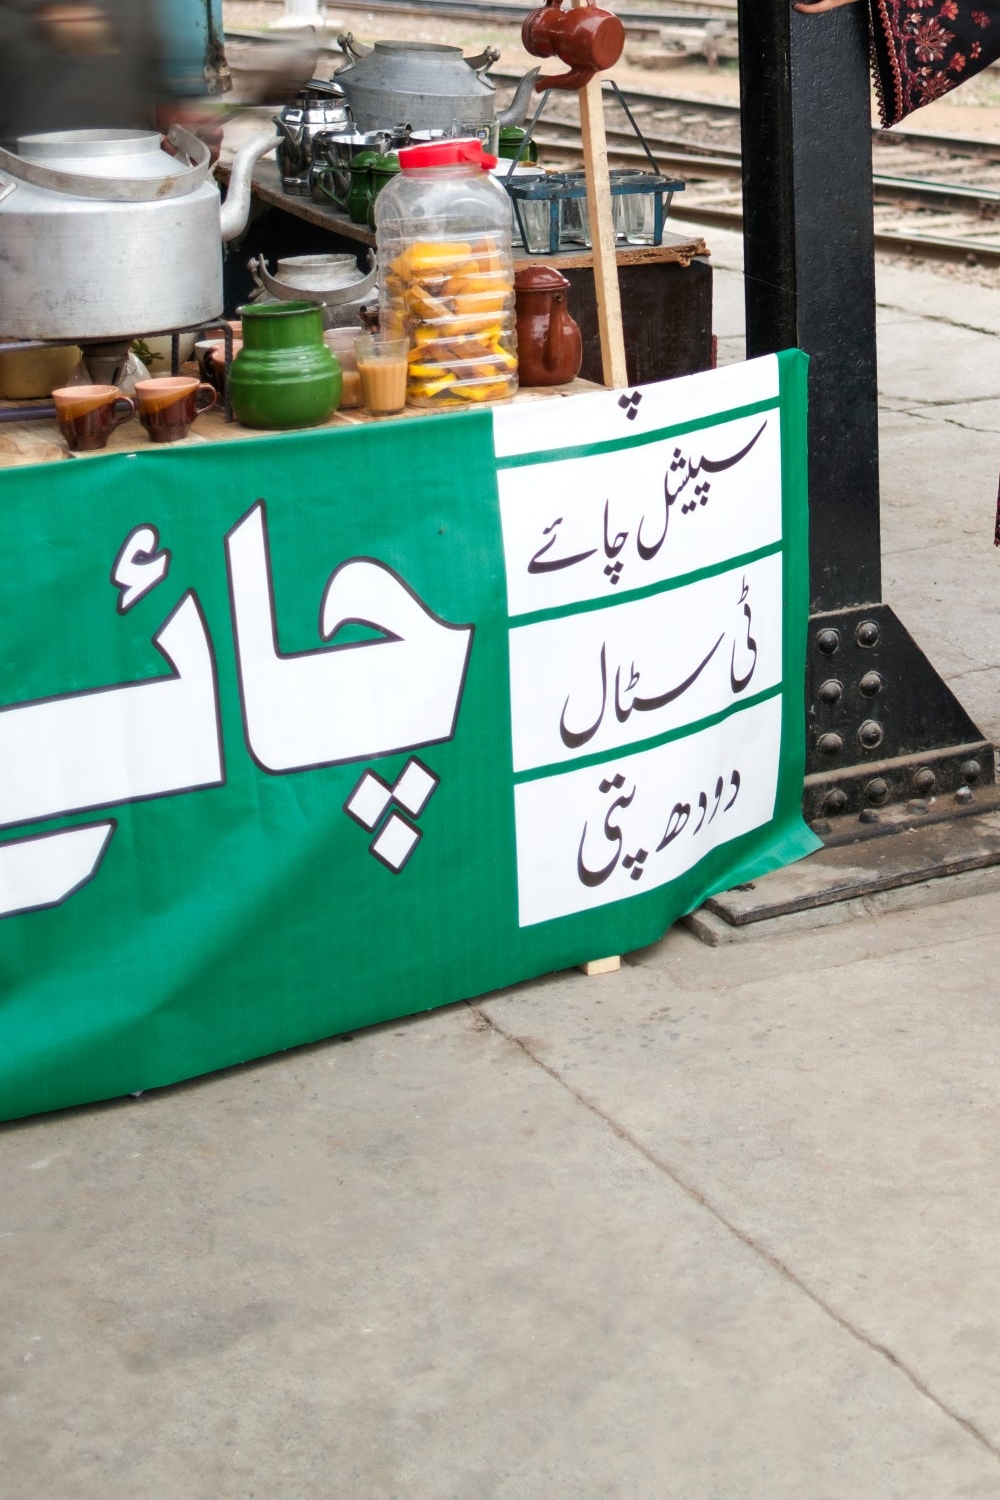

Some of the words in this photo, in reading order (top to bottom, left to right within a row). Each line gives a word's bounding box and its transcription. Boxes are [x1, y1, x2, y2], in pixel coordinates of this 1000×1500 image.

[526, 499, 629, 585] چائے
[636, 419, 768, 561] سپیشل
[559, 630, 726, 750] سٹال
[730, 574, 757, 694] ٹی
[577, 772, 650, 888] پتی
[655, 768, 741, 853] دودھ
